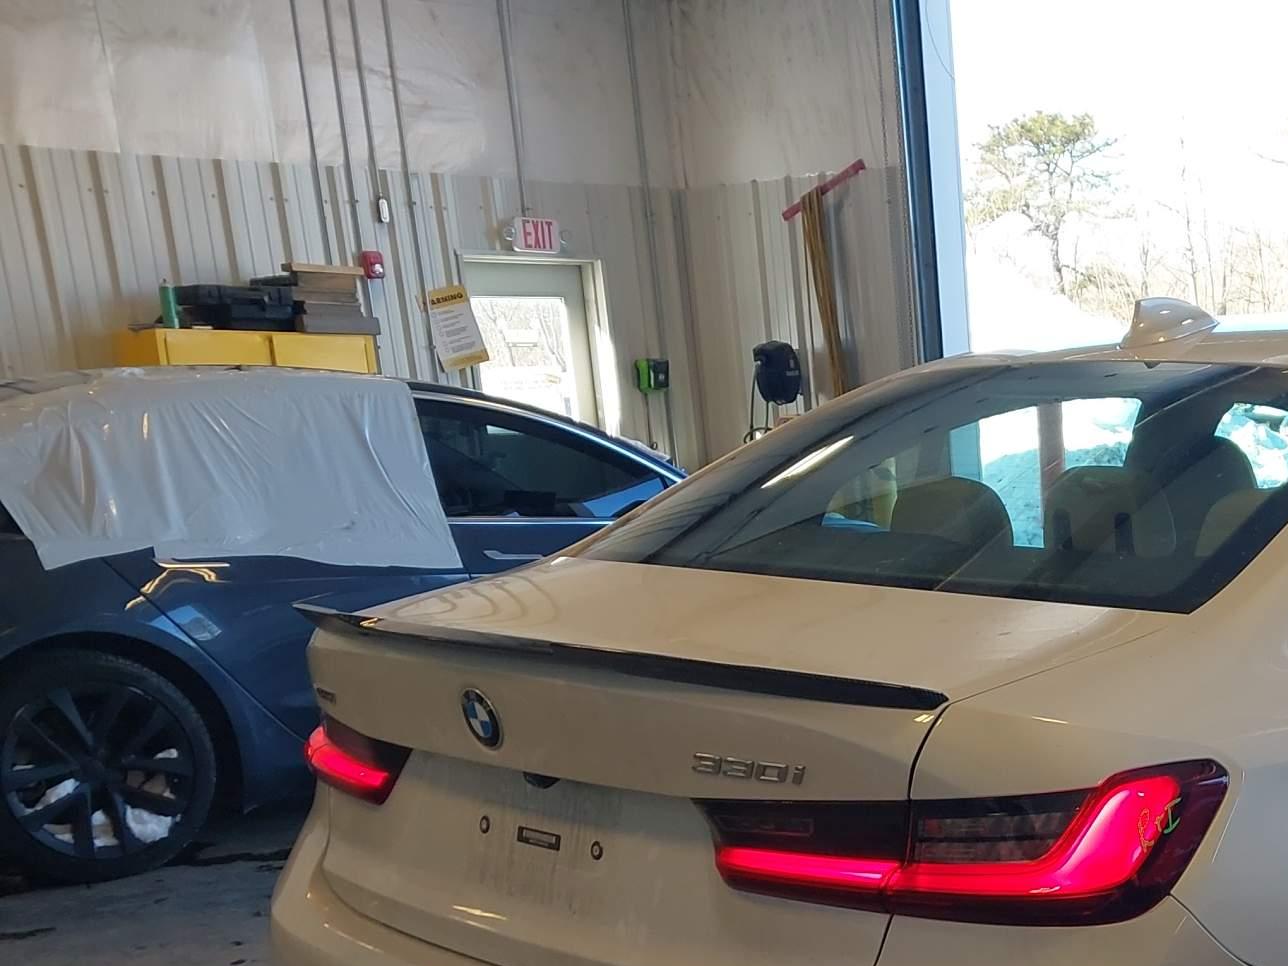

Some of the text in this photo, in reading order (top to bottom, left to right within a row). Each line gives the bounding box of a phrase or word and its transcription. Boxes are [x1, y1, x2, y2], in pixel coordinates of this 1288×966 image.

[521, 219, 553, 250] EXIT
[429, 291, 464, 306] ARNING
[691, 752, 806, 785] 330i
